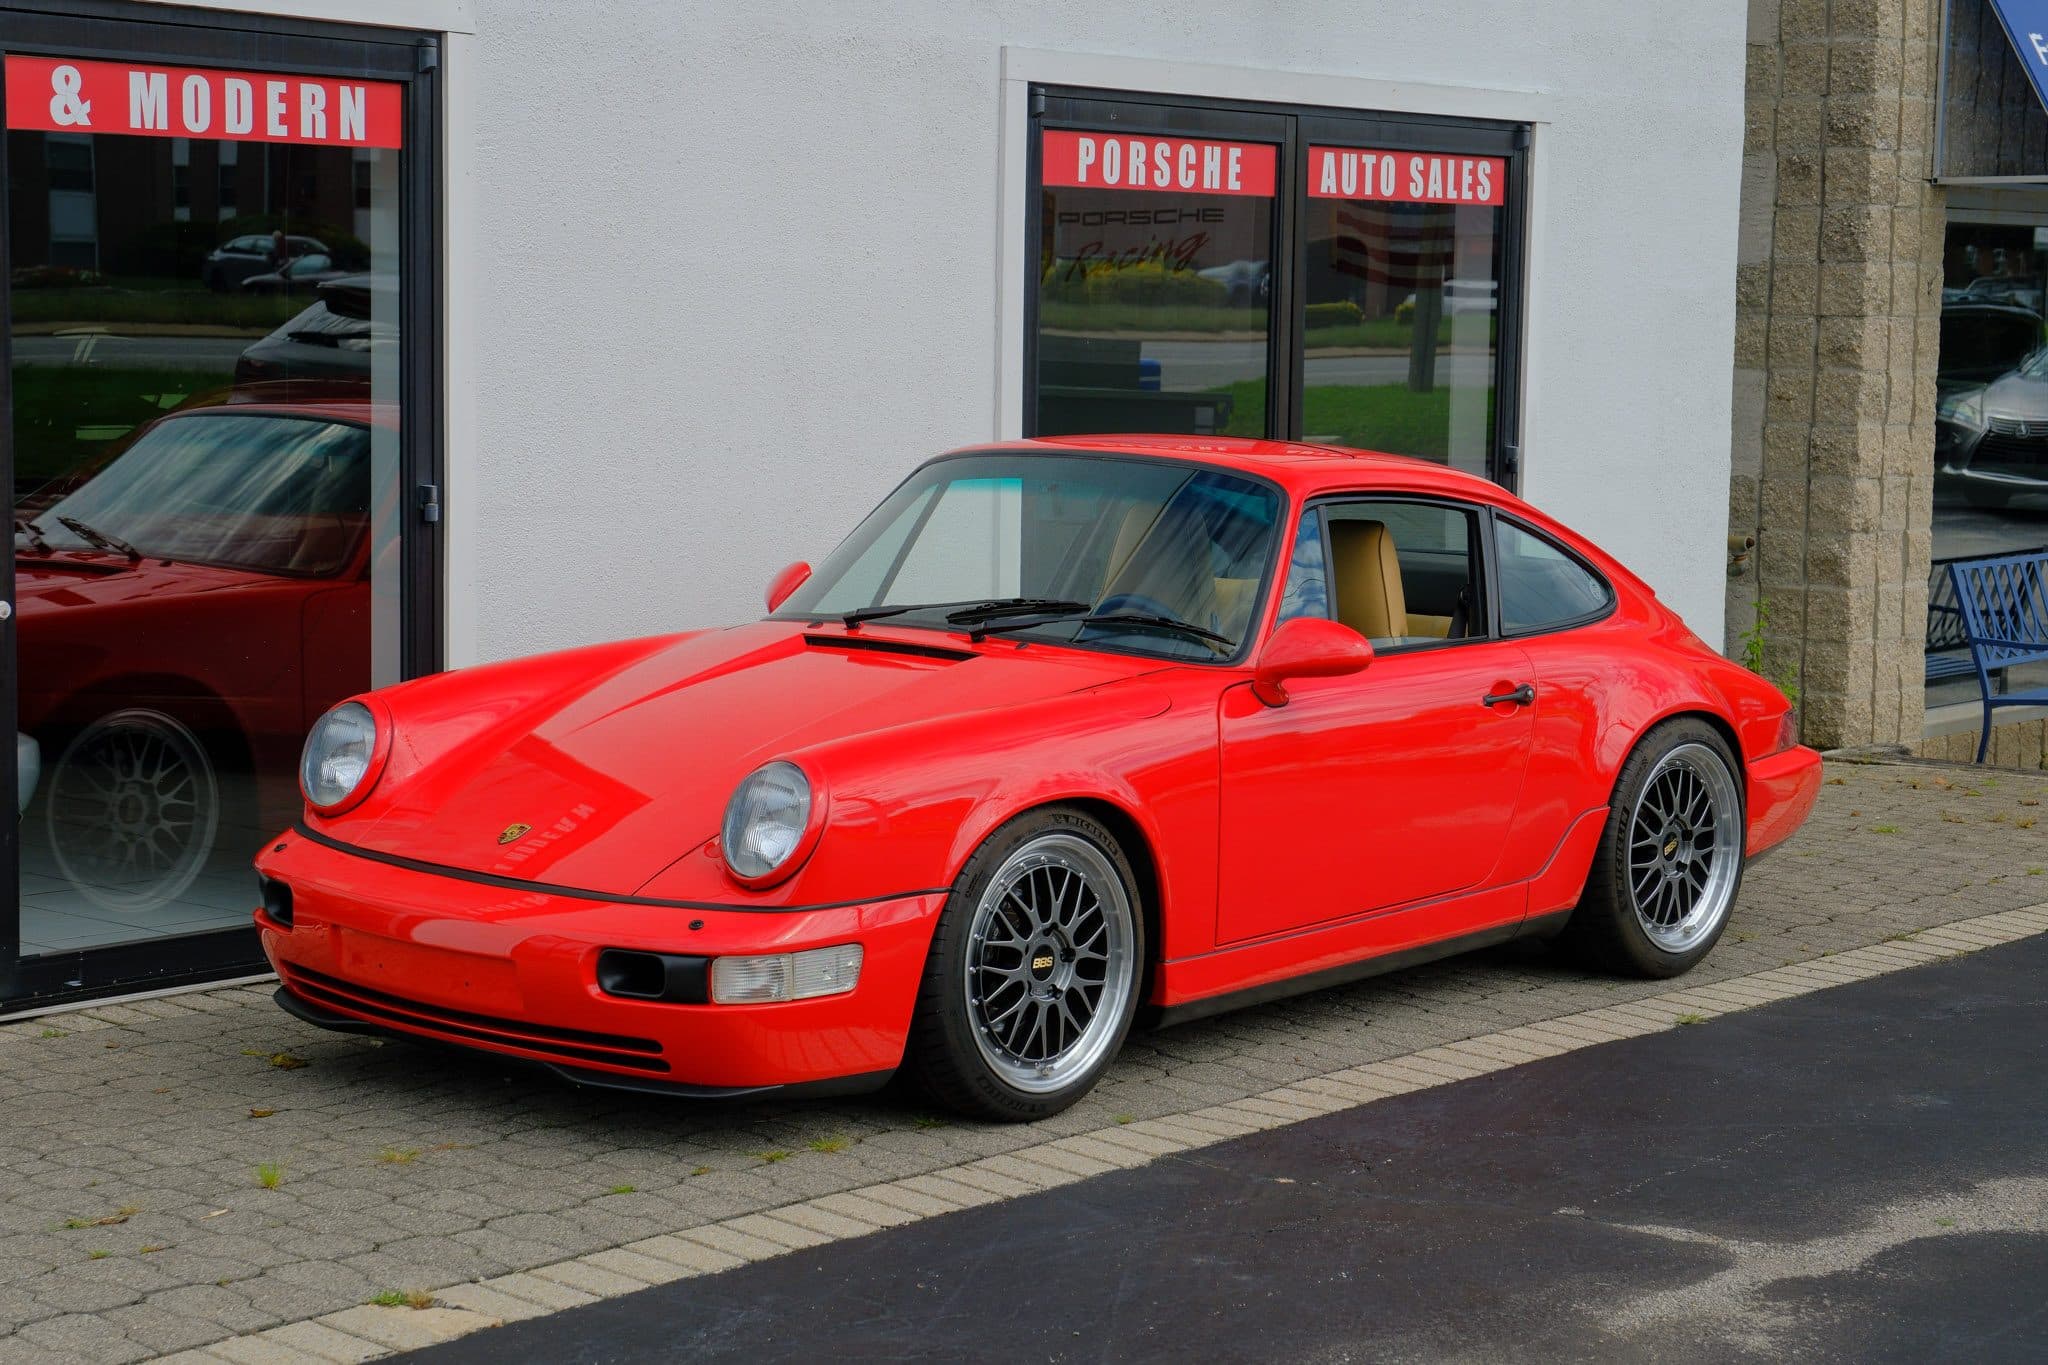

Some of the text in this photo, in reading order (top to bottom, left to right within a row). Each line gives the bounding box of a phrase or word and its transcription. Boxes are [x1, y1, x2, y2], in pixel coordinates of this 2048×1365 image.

[50, 66, 366, 141] & MODERN
[1078, 138, 1242, 191] PORSCHE
[1320, 152, 1491, 201] AUTO SALES
[1058, 208, 1225, 226] PORSCHE
[1065, 231, 1211, 282] Racing
[1032, 956, 1054, 969] BBS
